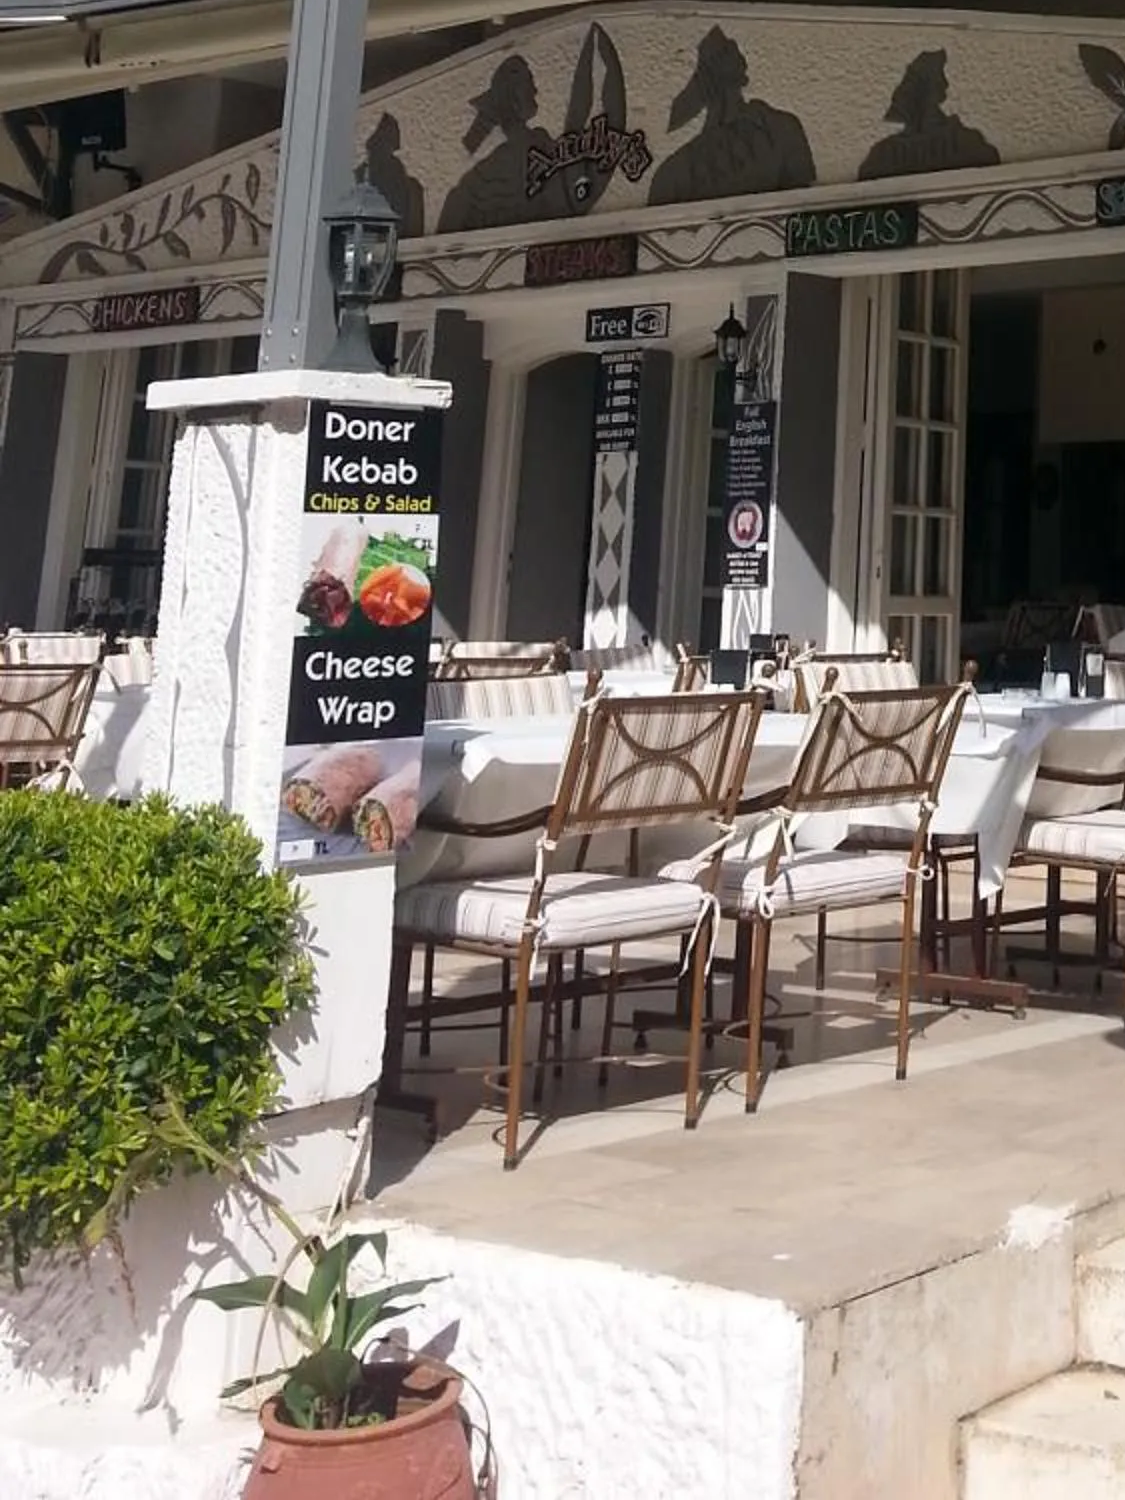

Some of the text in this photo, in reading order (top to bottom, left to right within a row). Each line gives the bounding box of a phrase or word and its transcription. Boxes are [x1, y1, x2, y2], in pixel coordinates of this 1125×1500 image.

[787, 208, 901, 253] PASTAS
[527, 242, 620, 279] STEAKS
[92, 291, 188, 327] CHICKENS
[590, 314, 628, 336] Free
[325, 411, 416, 442] Doner
[323, 455, 418, 485] Kebab
[310, 493, 432, 514] Chips & Salad
[305, 651, 415, 681] Cheese
[317, 696, 396, 729] Wrap
